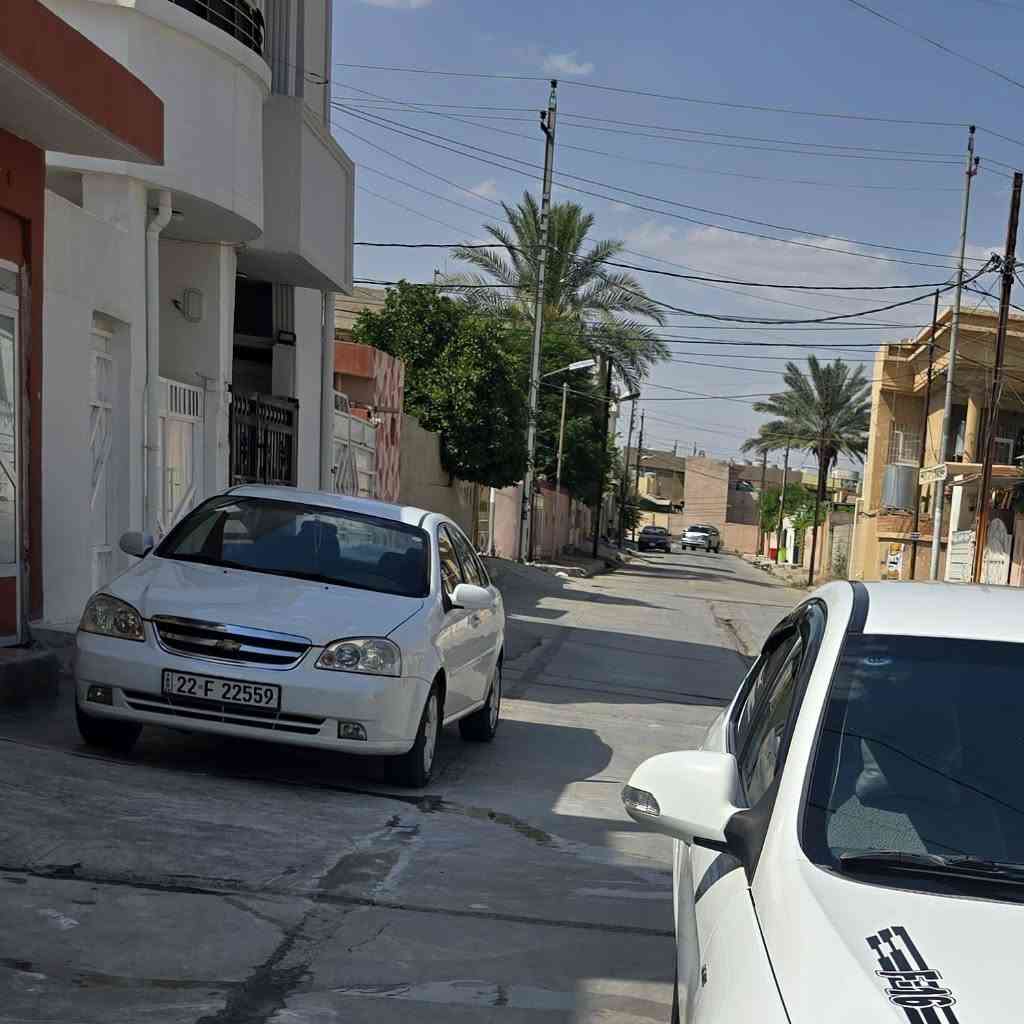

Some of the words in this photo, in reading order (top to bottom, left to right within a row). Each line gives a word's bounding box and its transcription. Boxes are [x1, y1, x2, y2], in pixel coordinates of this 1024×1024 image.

[177, 676, 197, 695] 22
[204, 680, 214, 697] F
[222, 683, 274, 705] 22559
